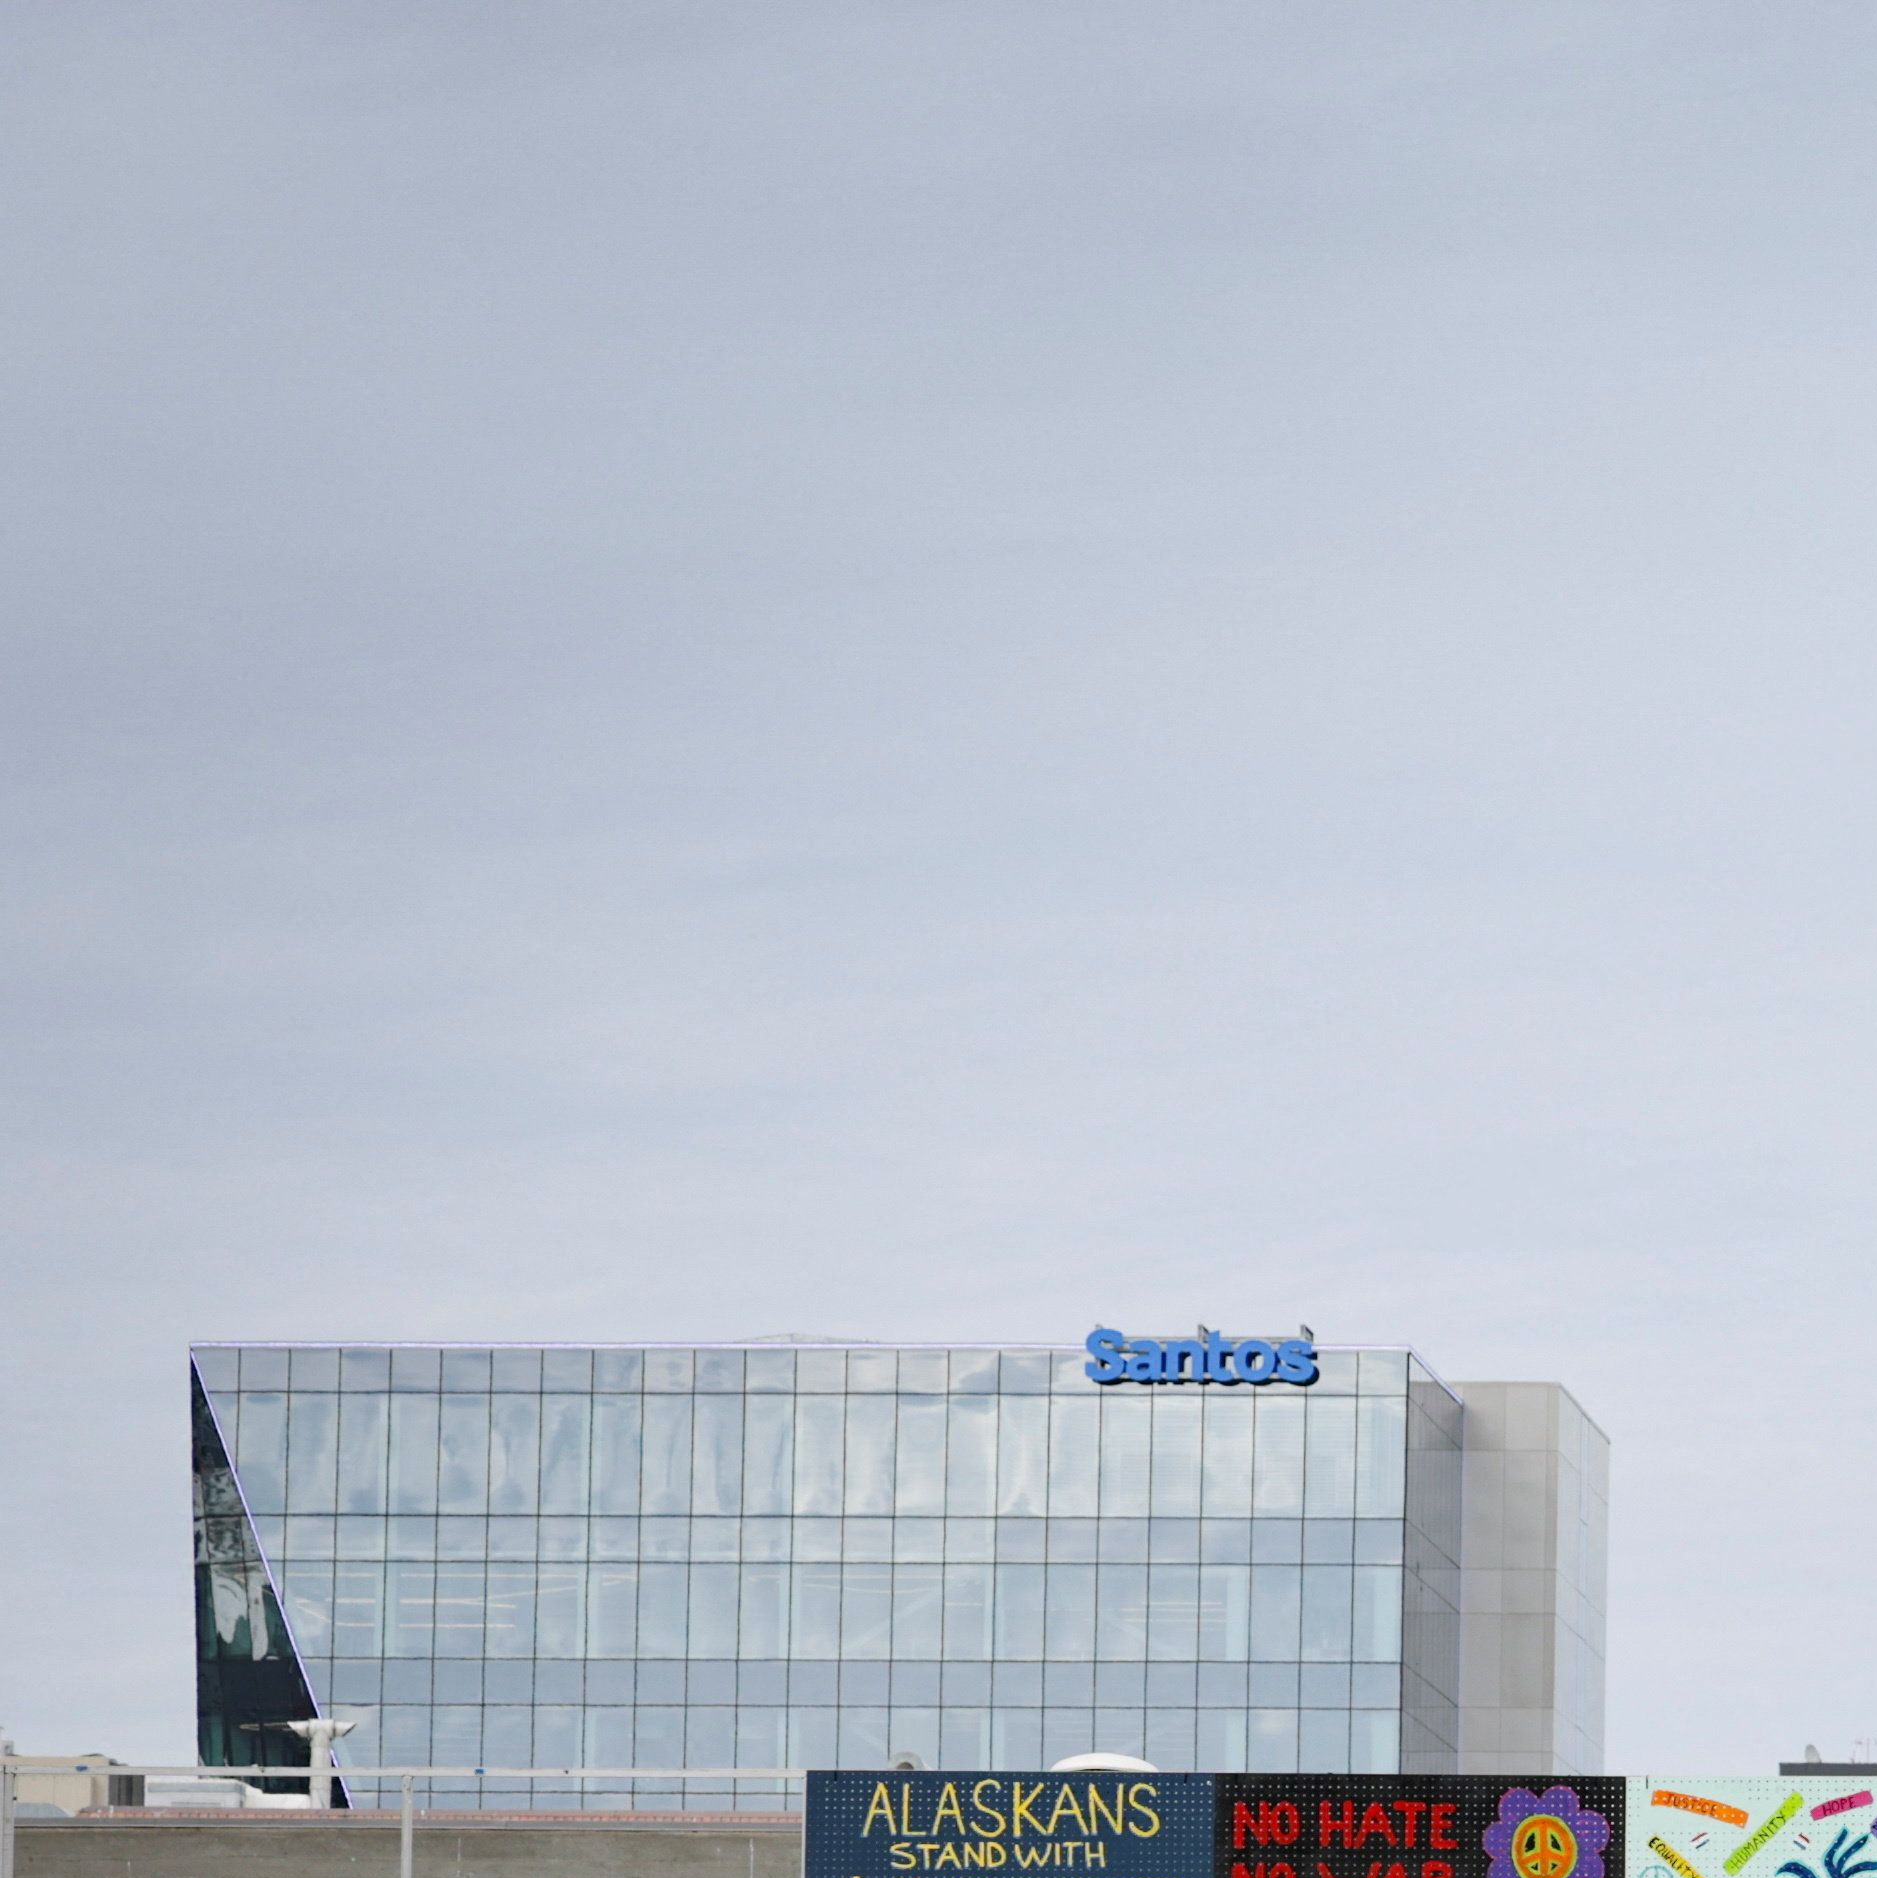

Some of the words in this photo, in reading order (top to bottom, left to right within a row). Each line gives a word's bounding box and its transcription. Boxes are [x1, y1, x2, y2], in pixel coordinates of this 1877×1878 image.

[1085, 1328, 1319, 1385] Santos
[863, 1779, 1160, 1839] ALASKANS
[1232, 1802, 1299, 1849] NO
[1320, 1801, 1458, 1850] HATE
[1663, 1793, 1718, 1816] JUSTICE
[1822, 1796, 1857, 1817] HOPE
[889, 1842, 1006, 1871] STAND
[1013, 1842, 1107, 1869] WITH
[1730, 1810, 1788, 1870] HUMANITY
